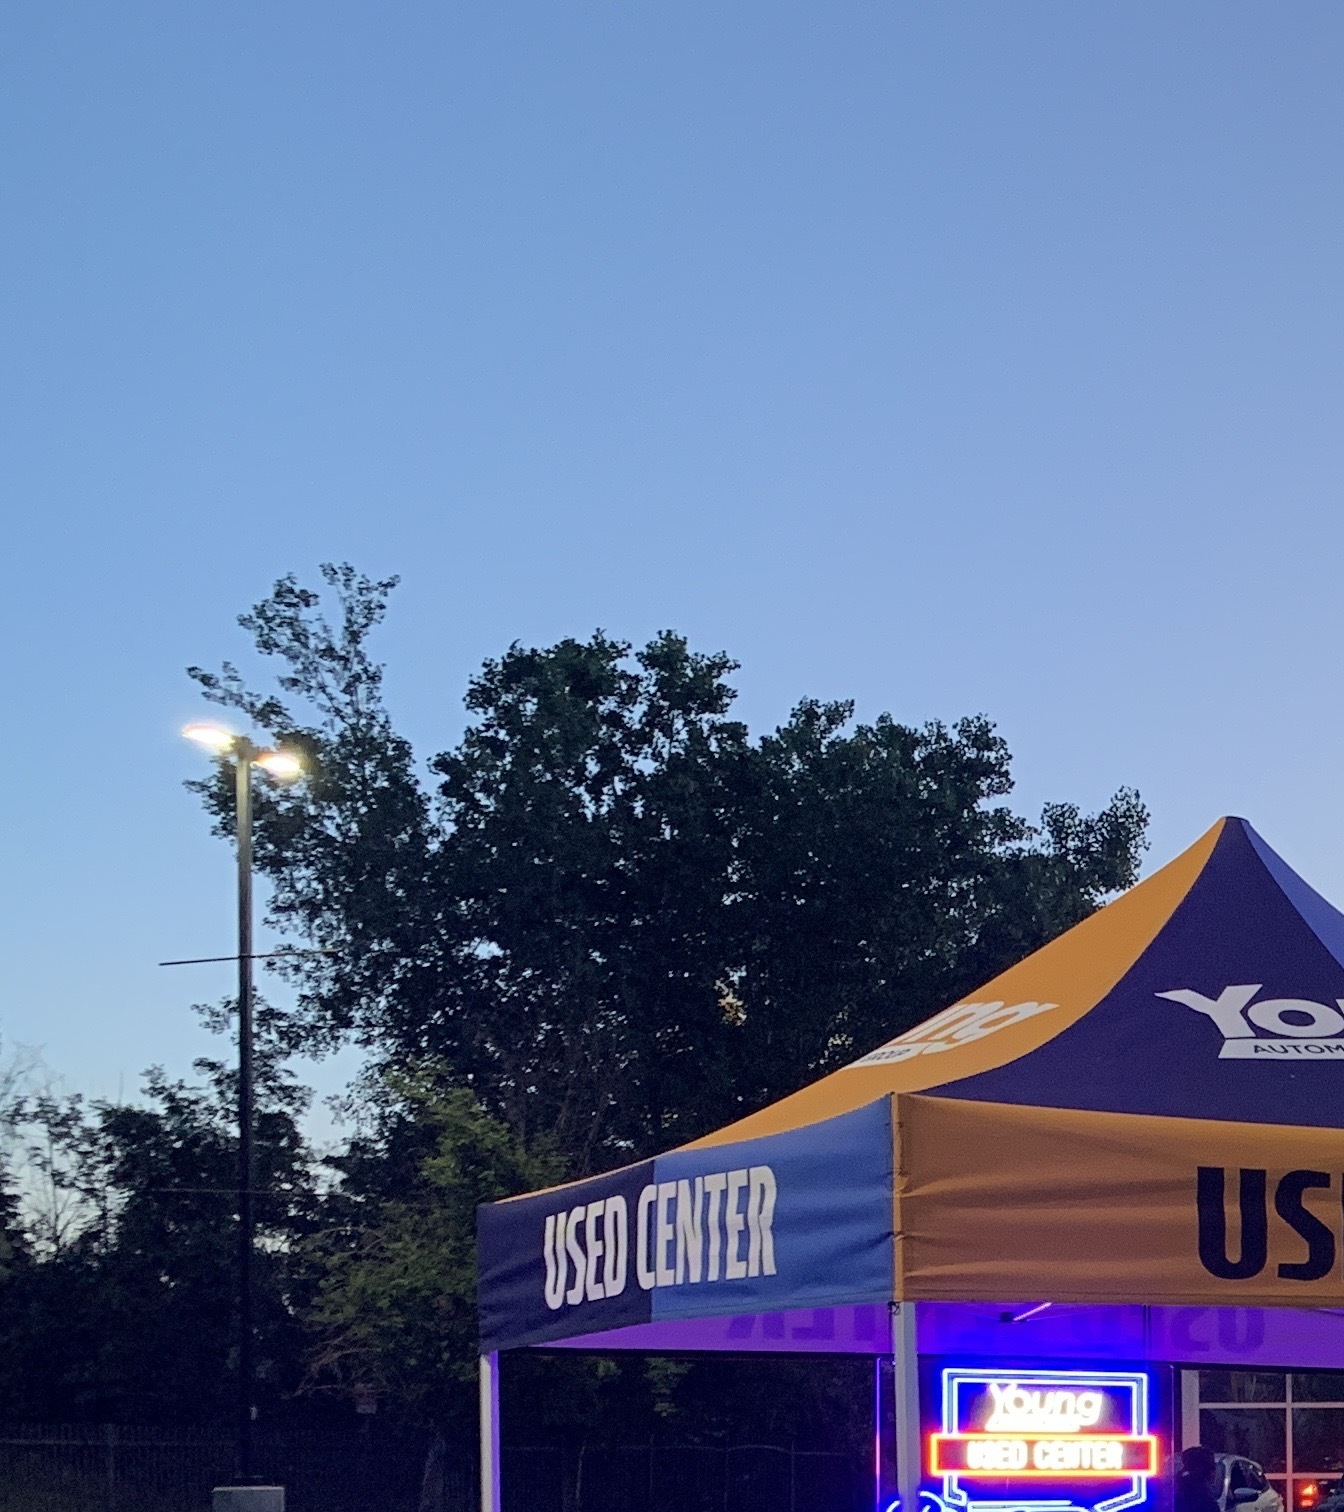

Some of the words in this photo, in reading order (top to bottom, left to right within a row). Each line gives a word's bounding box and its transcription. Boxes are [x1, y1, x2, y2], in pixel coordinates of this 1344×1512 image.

[543, 1195, 628, 1310] USED
[636, 1165, 777, 1290] CENTER
[987, 1382, 1103, 1427] Young
[967, 1440, 1028, 1470] USED
[1033, 1440, 1124, 1470] CENTER
